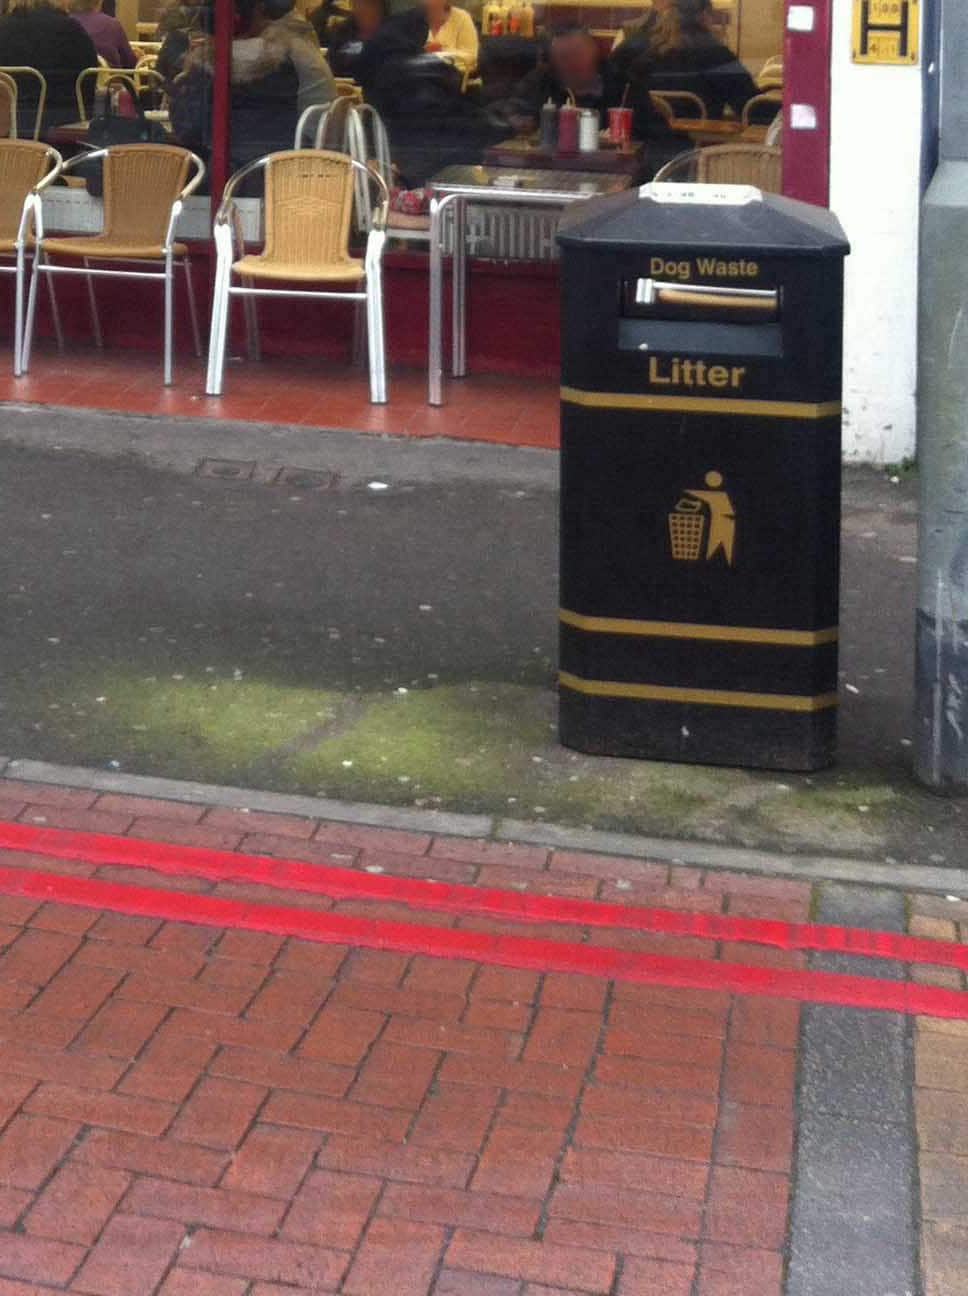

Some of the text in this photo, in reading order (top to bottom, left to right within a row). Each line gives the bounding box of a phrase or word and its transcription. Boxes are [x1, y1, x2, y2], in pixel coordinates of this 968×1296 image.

[860, 0, 909, 57] H
[650, 257, 760, 280] Dog Waste
[648, 355, 747, 388] Litter
